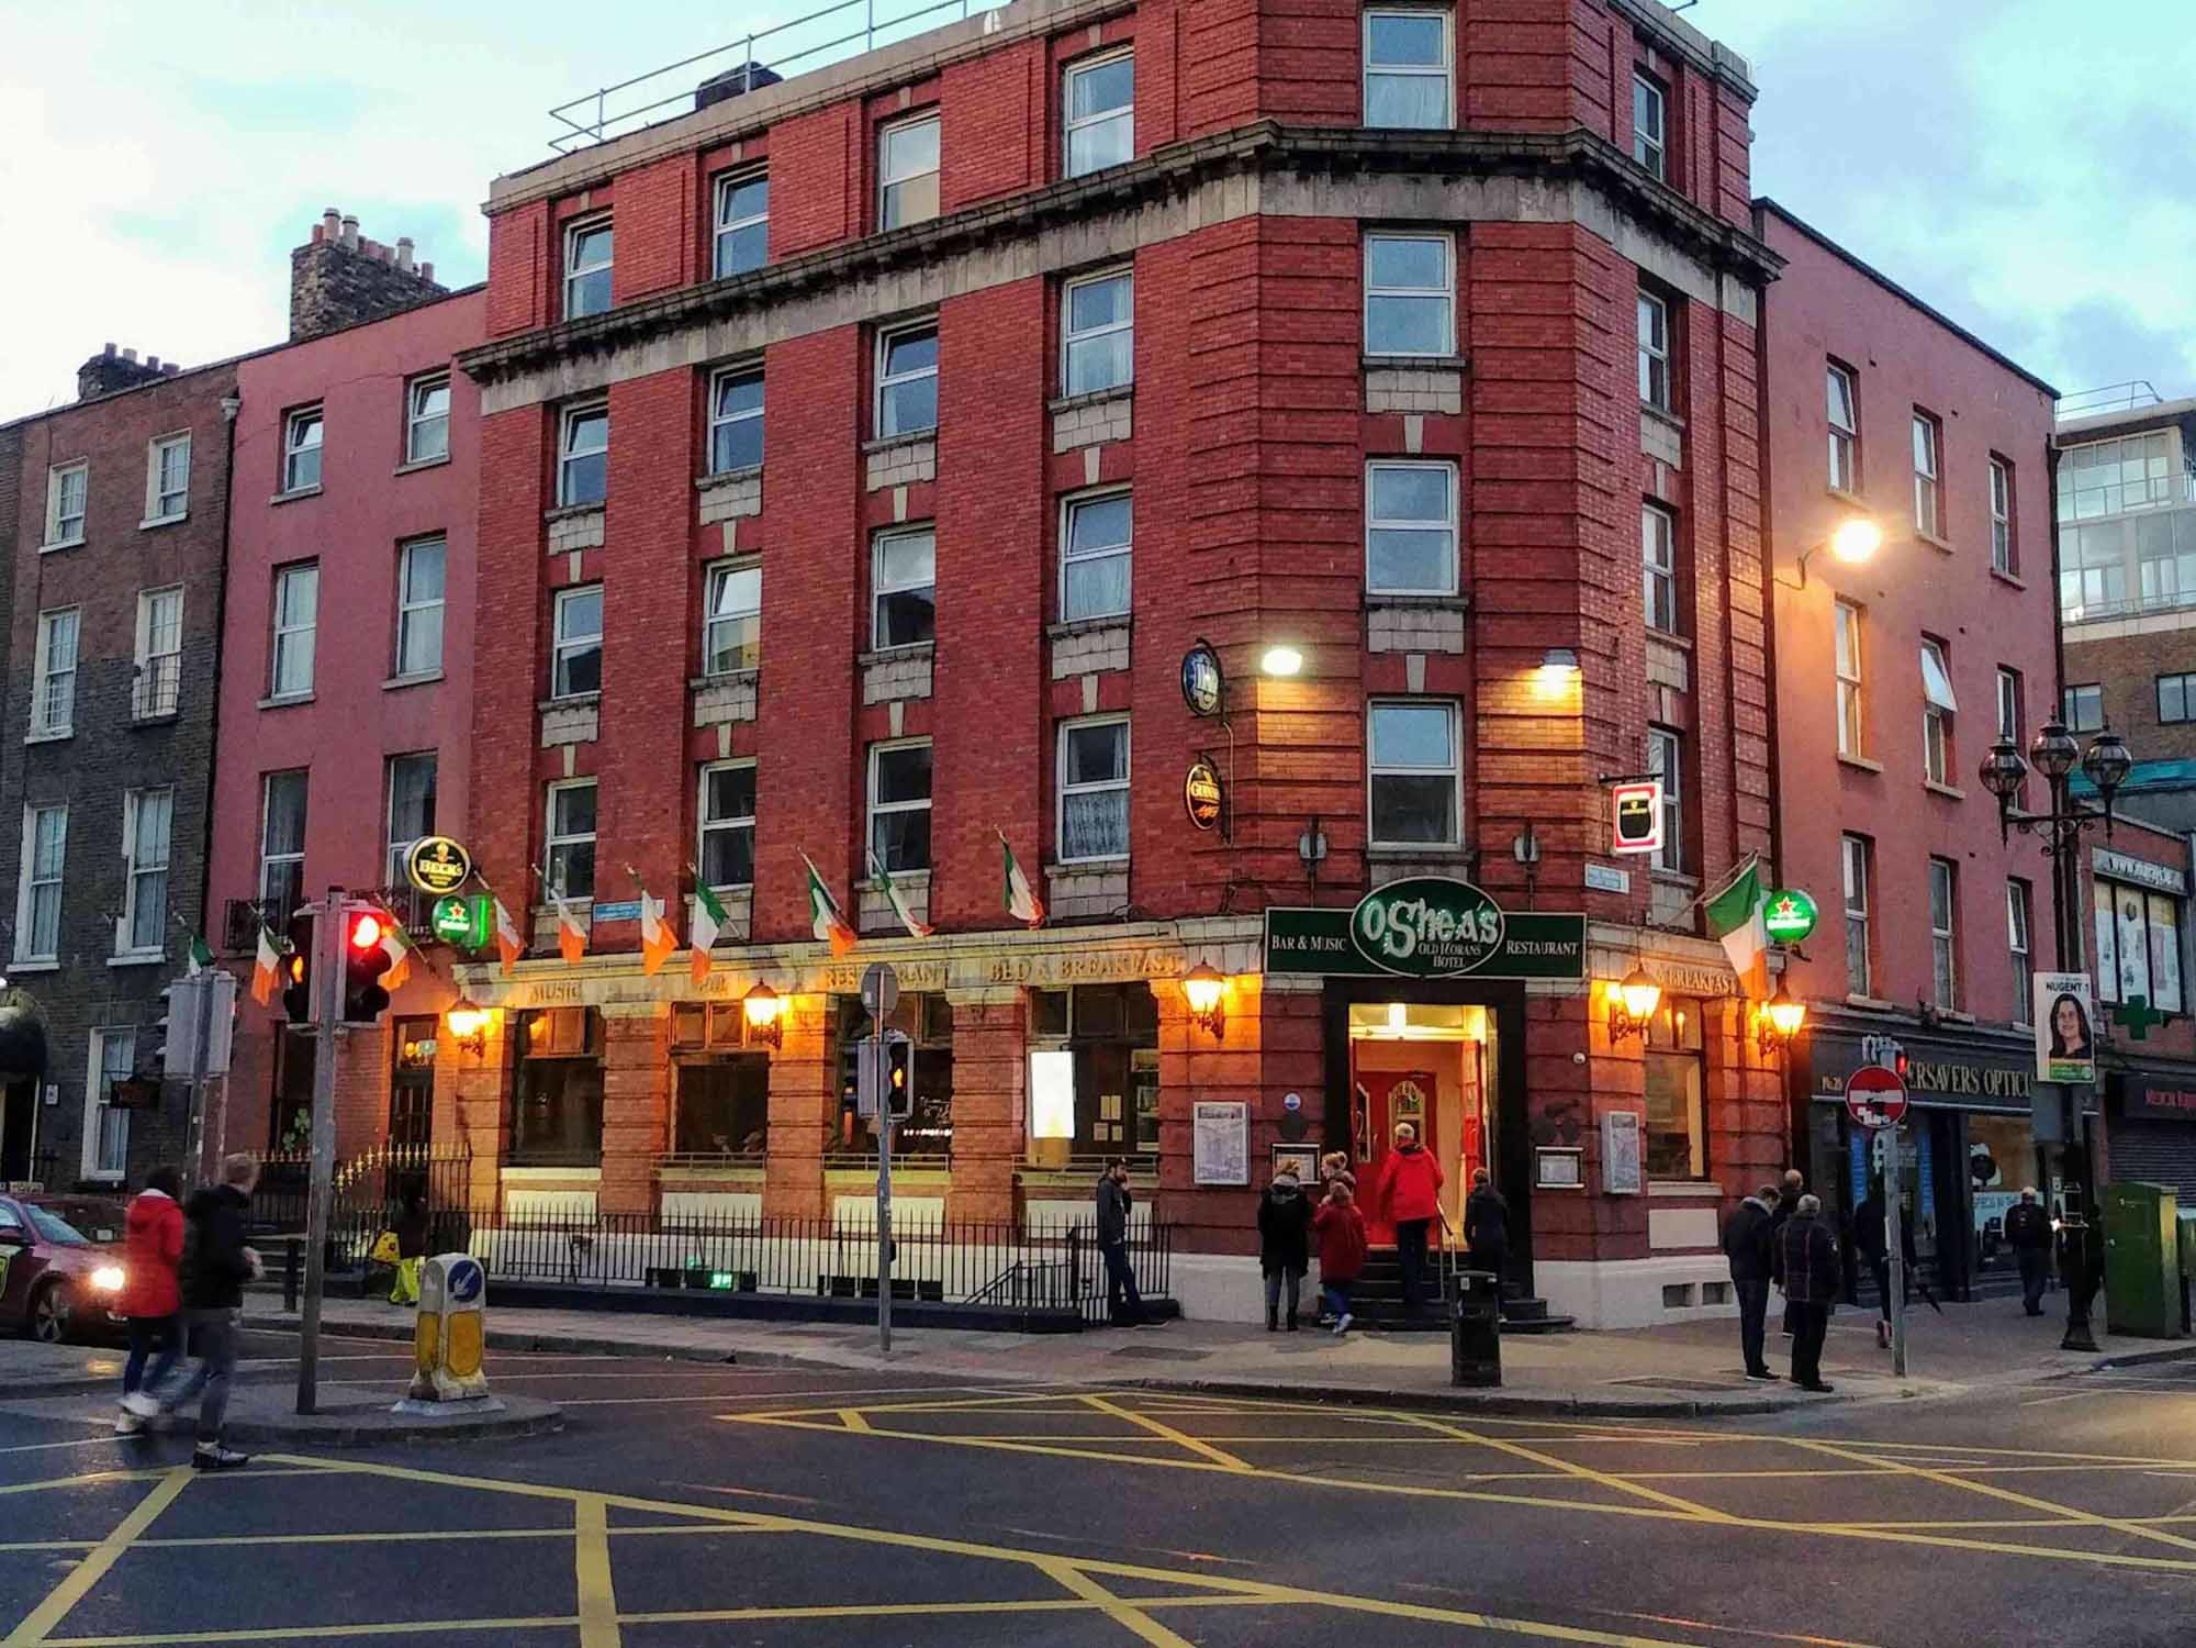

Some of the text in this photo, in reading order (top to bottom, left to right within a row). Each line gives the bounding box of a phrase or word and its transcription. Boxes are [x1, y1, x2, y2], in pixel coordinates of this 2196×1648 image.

[1272, 934, 1347, 951] BAR & MUSIC
[1506, 940, 1579, 955] RESTAURANT
[1061, 951, 1186, 977] BREAKFAST
[1433, 956, 1466, 968] HOTEL
[826, 961, 951, 987] RESRANT
[1668, 966, 1738, 994] BREAKFAST
